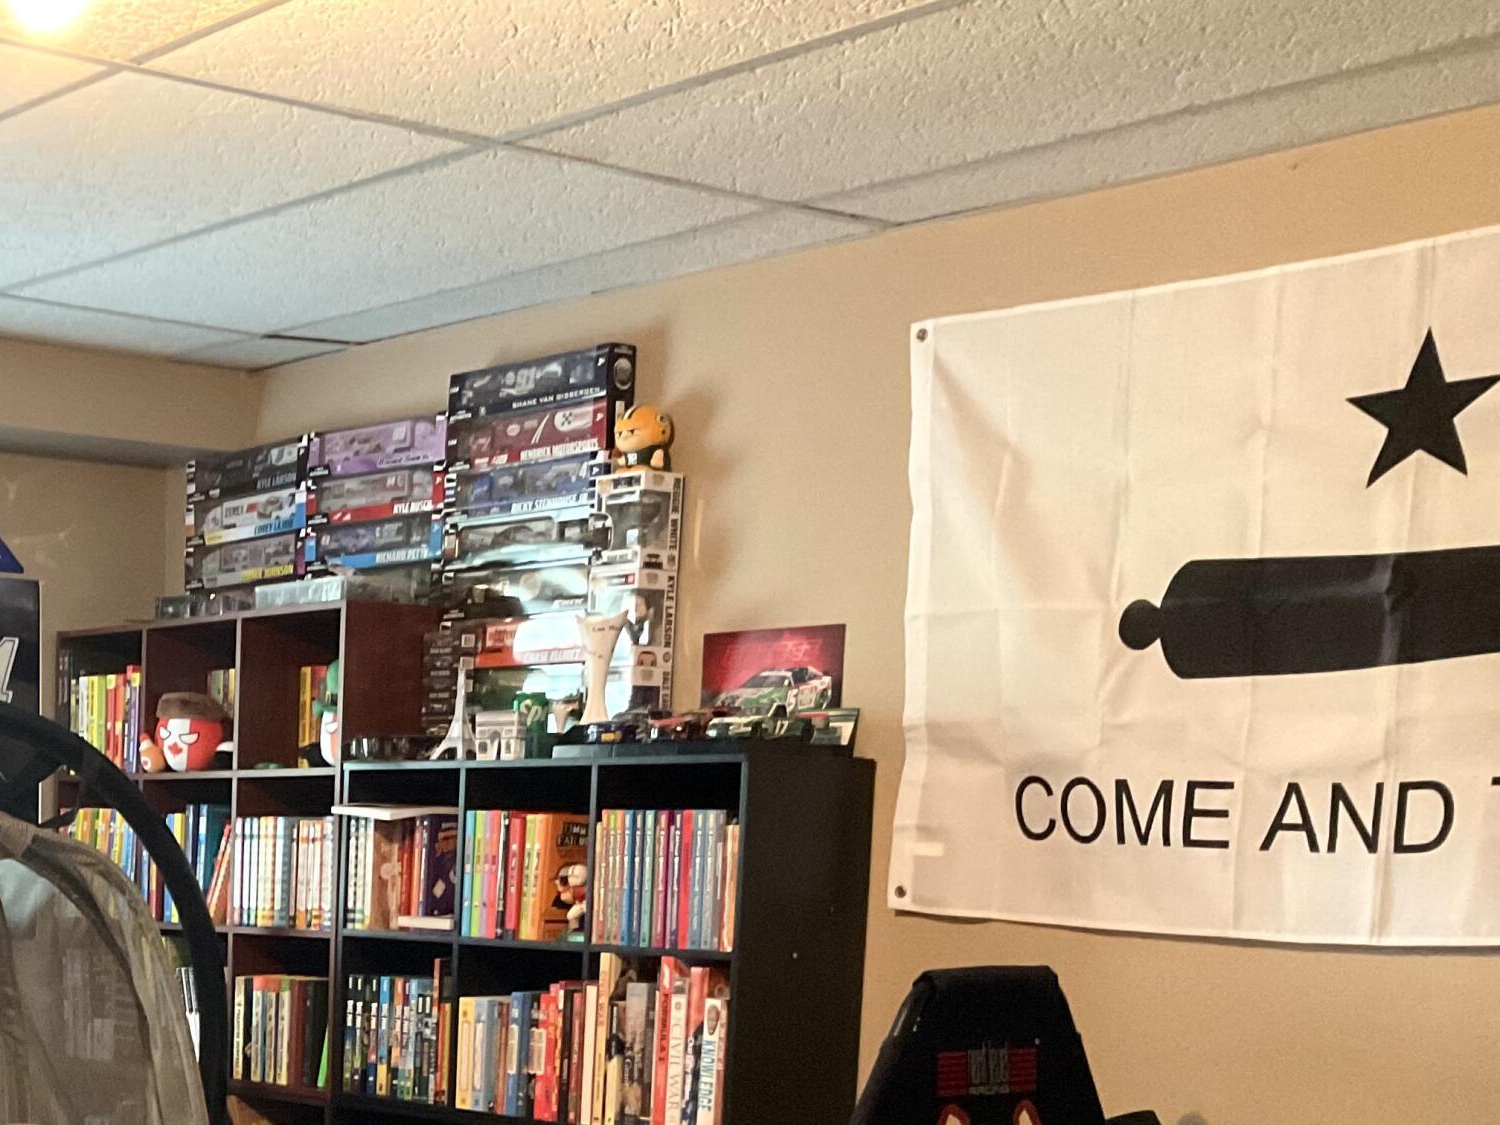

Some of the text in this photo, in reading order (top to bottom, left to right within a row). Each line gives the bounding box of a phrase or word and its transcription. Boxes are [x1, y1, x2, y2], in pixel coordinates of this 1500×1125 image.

[512, 399, 537, 409] SHANE
[539, 395, 554, 403] VAN
[393, 500, 433, 514] KYLE BUSCH
[664, 576, 675, 648] KYLE LARSON
[1015, 775, 1455, 855] COME AND
[660, 993, 669, 1053] FORMULA
[666, 1022, 682, 1109] CIVIL WAR
[699, 1040, 717, 1112] KNOWLEDGE
